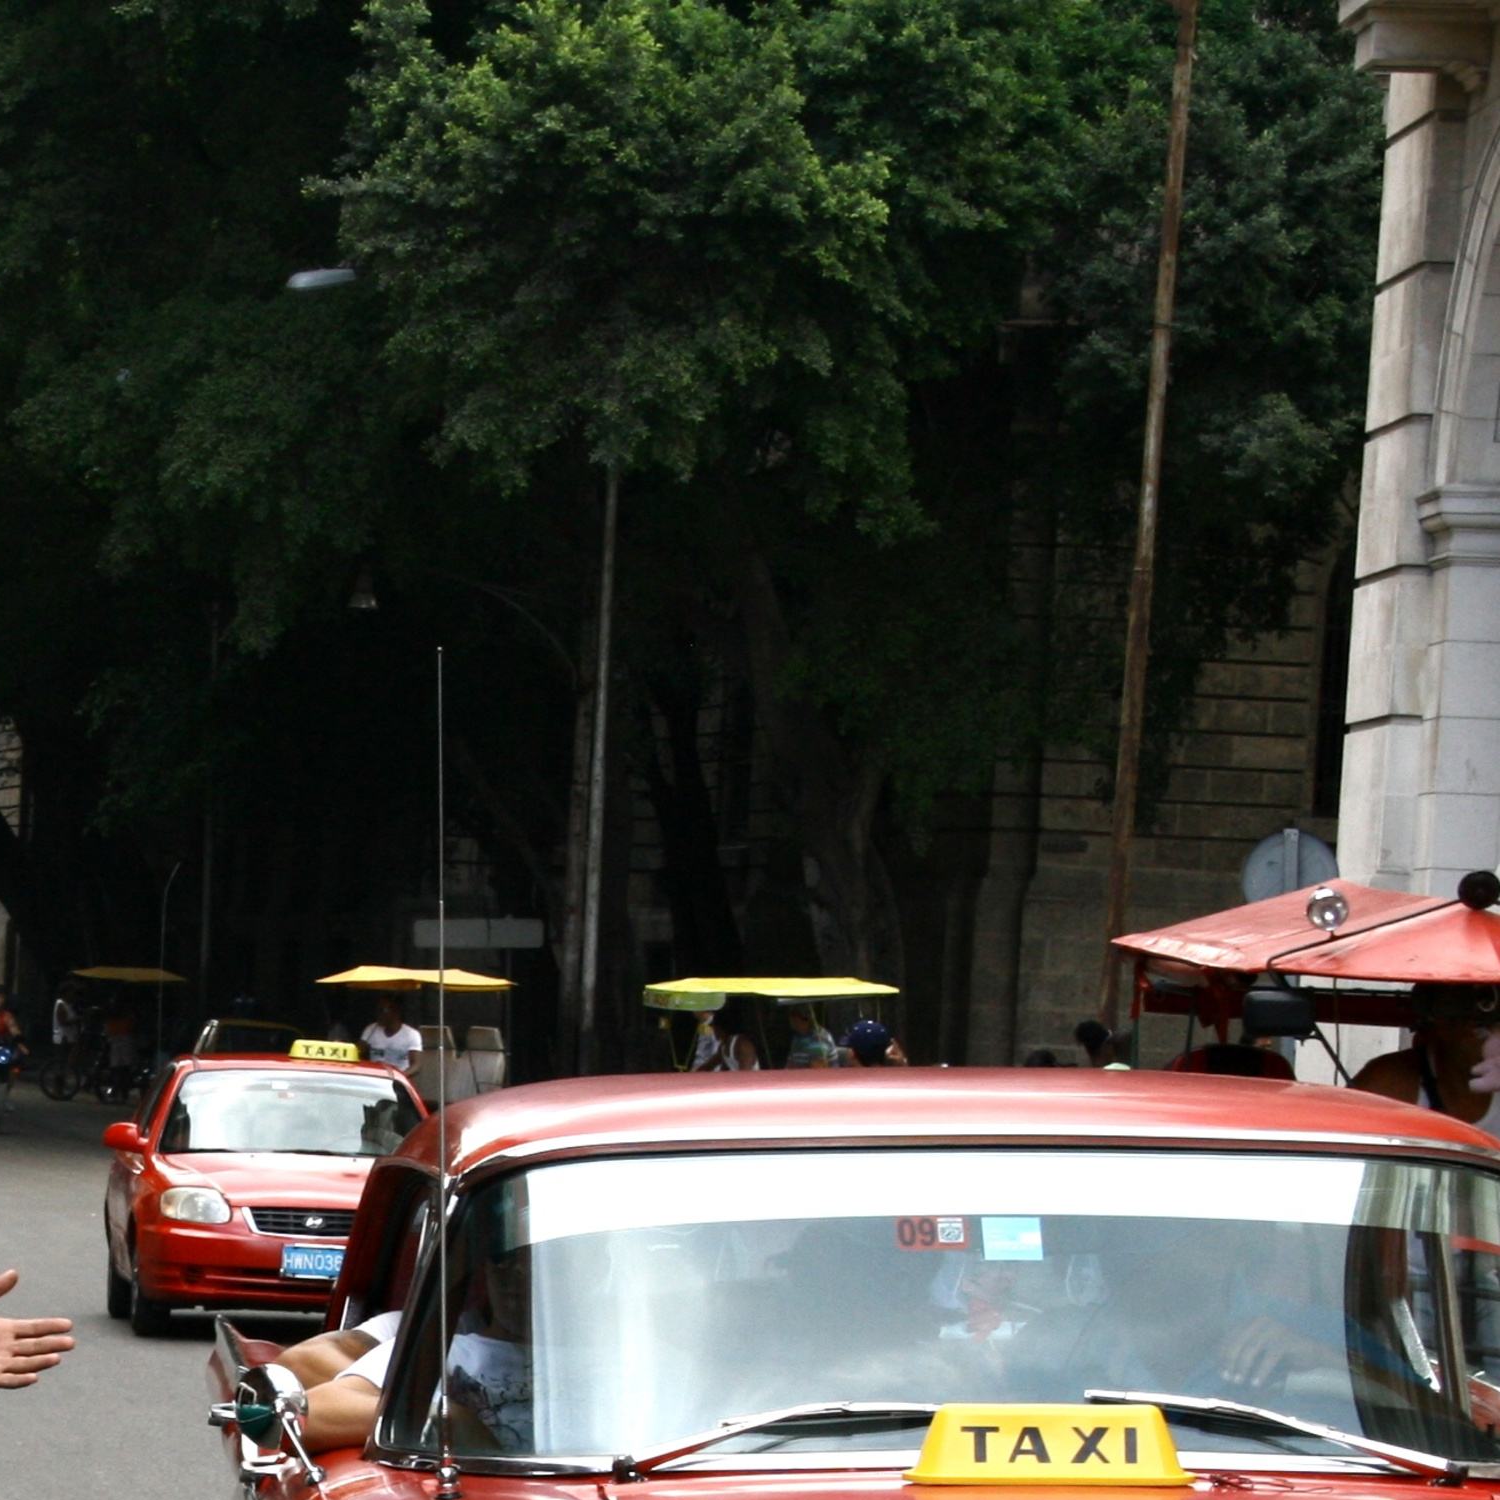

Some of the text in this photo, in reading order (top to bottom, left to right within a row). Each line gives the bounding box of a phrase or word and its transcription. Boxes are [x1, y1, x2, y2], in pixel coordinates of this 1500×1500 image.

[301, 1044, 348, 1059] TAXI
[898, 1218, 935, 1246] 09
[961, 1426, 1138, 1465] TAXI
